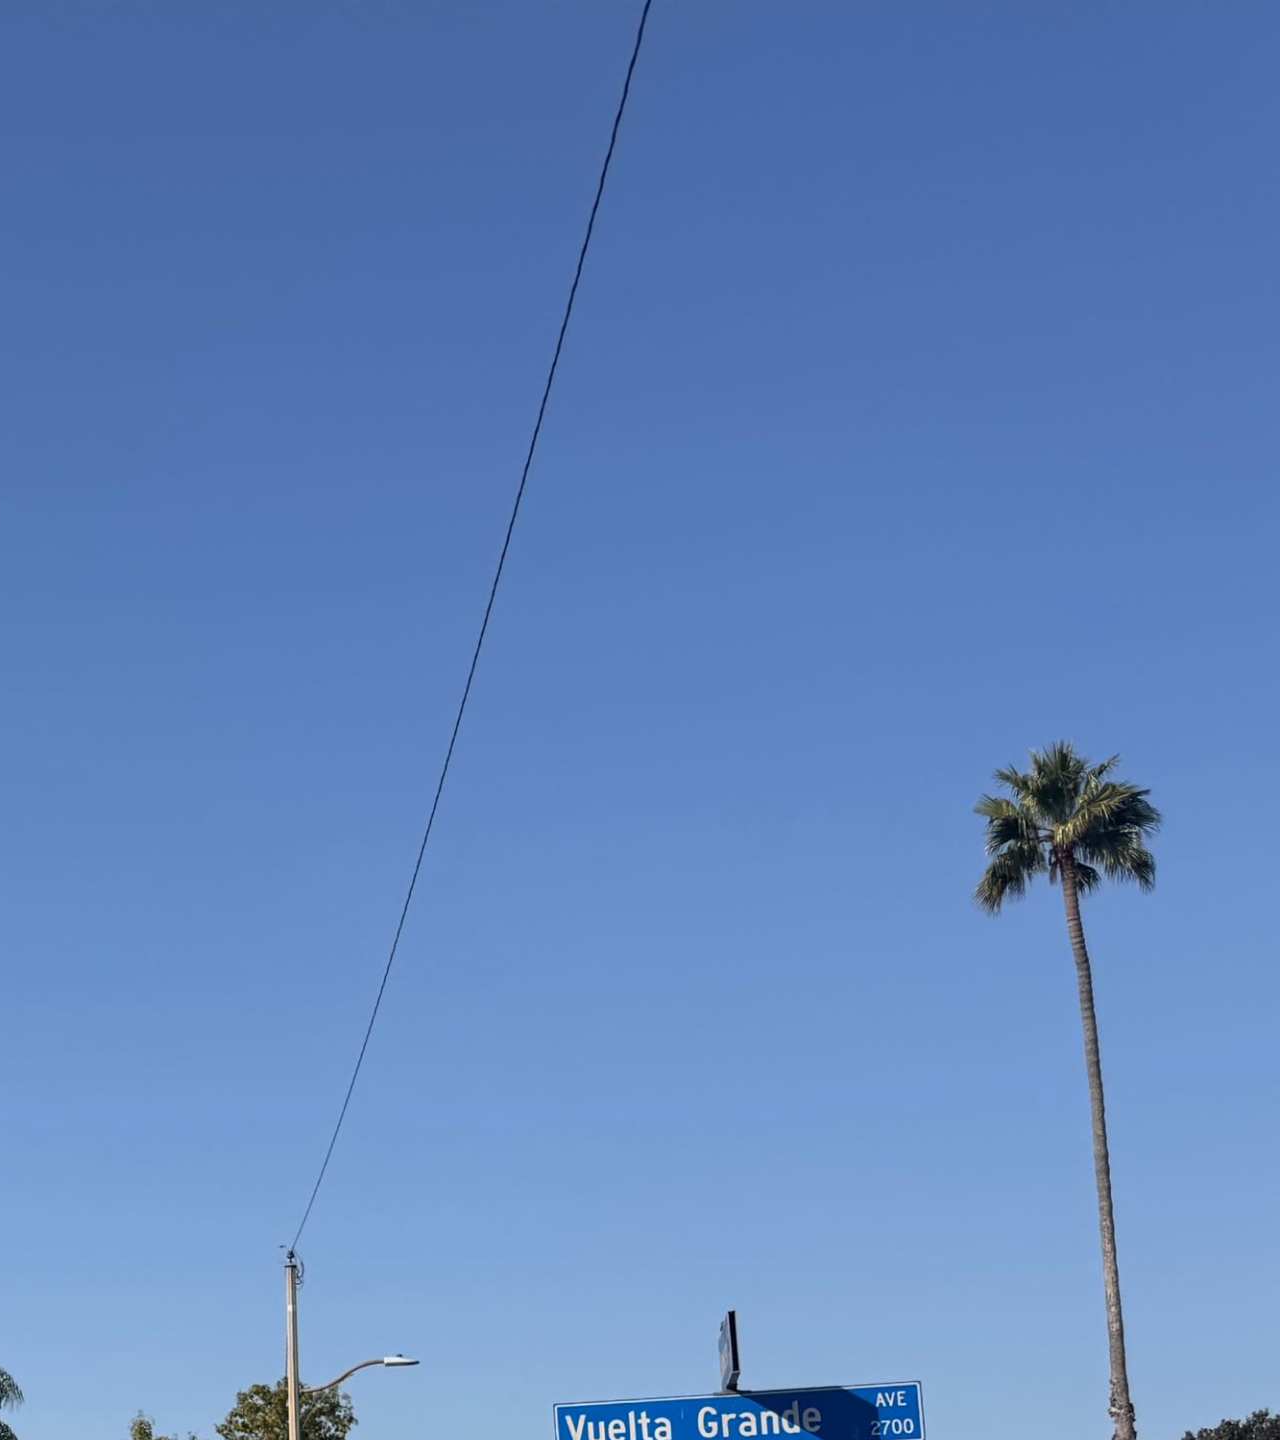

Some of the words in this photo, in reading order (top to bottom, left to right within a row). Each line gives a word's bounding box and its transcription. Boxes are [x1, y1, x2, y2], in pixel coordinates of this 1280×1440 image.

[875, 1390, 907, 1408] AVE
[697, 1400, 822, 1438] Grande
[870, 1417, 914, 1437] 2700
